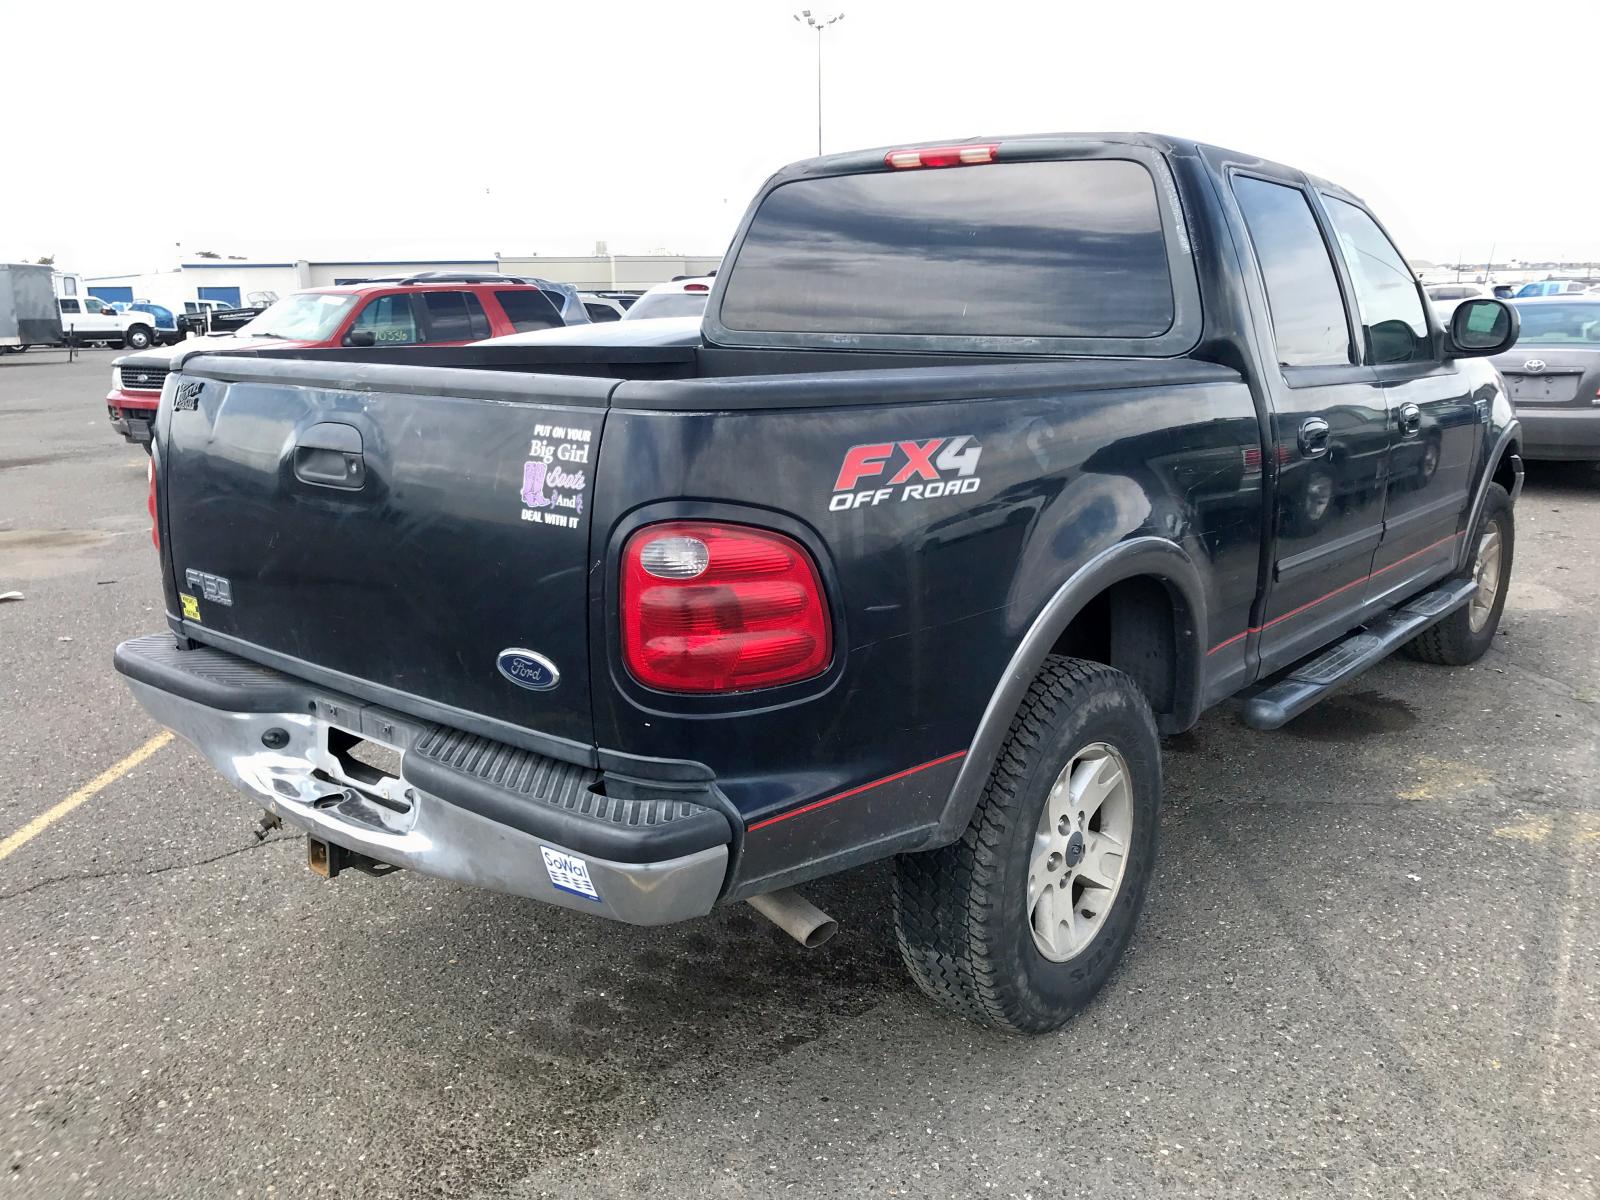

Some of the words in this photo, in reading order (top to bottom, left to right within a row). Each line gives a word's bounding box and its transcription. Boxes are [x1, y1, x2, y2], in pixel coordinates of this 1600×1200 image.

[533, 424, 552, 436] PUT
[552, 426, 565, 439] ON
[567, 428, 592, 442] YOUR
[529, 439, 555, 464] Big
[557, 443, 590, 464] Girl
[833, 434, 983, 492] FX4
[546, 466, 586, 490] Boots
[828, 487, 893, 512] OFF
[900, 477, 981, 502] ROAD
[521, 508, 543, 523] DEAL
[544, 512, 567, 528] WITH
[568, 516, 579, 529] IT
[510, 657, 542, 681] Ford
[544, 851, 587, 879] SoWal
